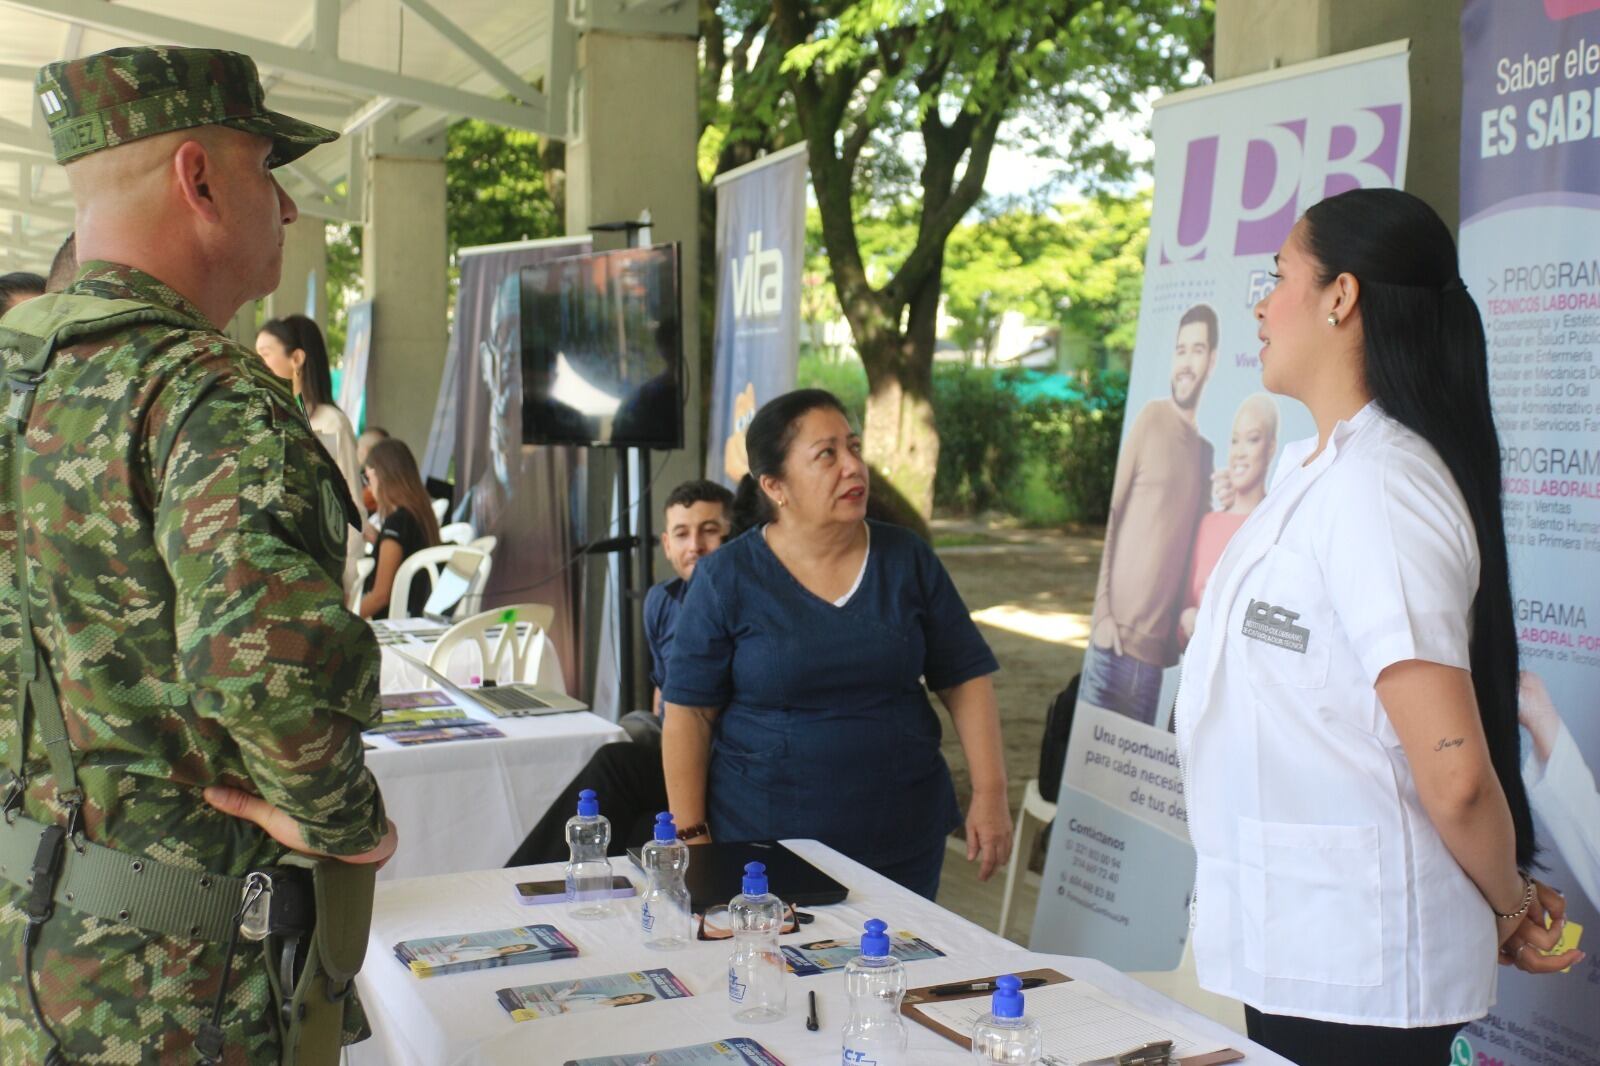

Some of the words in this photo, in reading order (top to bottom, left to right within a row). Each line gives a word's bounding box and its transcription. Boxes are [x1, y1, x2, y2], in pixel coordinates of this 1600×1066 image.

[1496, 52, 1560, 95] Saber
[1564, 38, 1600, 79] ele
[1481, 104, 1517, 159] ES
[731, 230, 784, 320] vita
[1534, 499, 1572, 514] Ventas
[1093, 724, 1117, 746] Una
[1085, 749, 1111, 775] para
[1112, 760, 1138, 778] cada
[1129, 785, 1146, 805] de
[1147, 796, 1166, 814] tus
